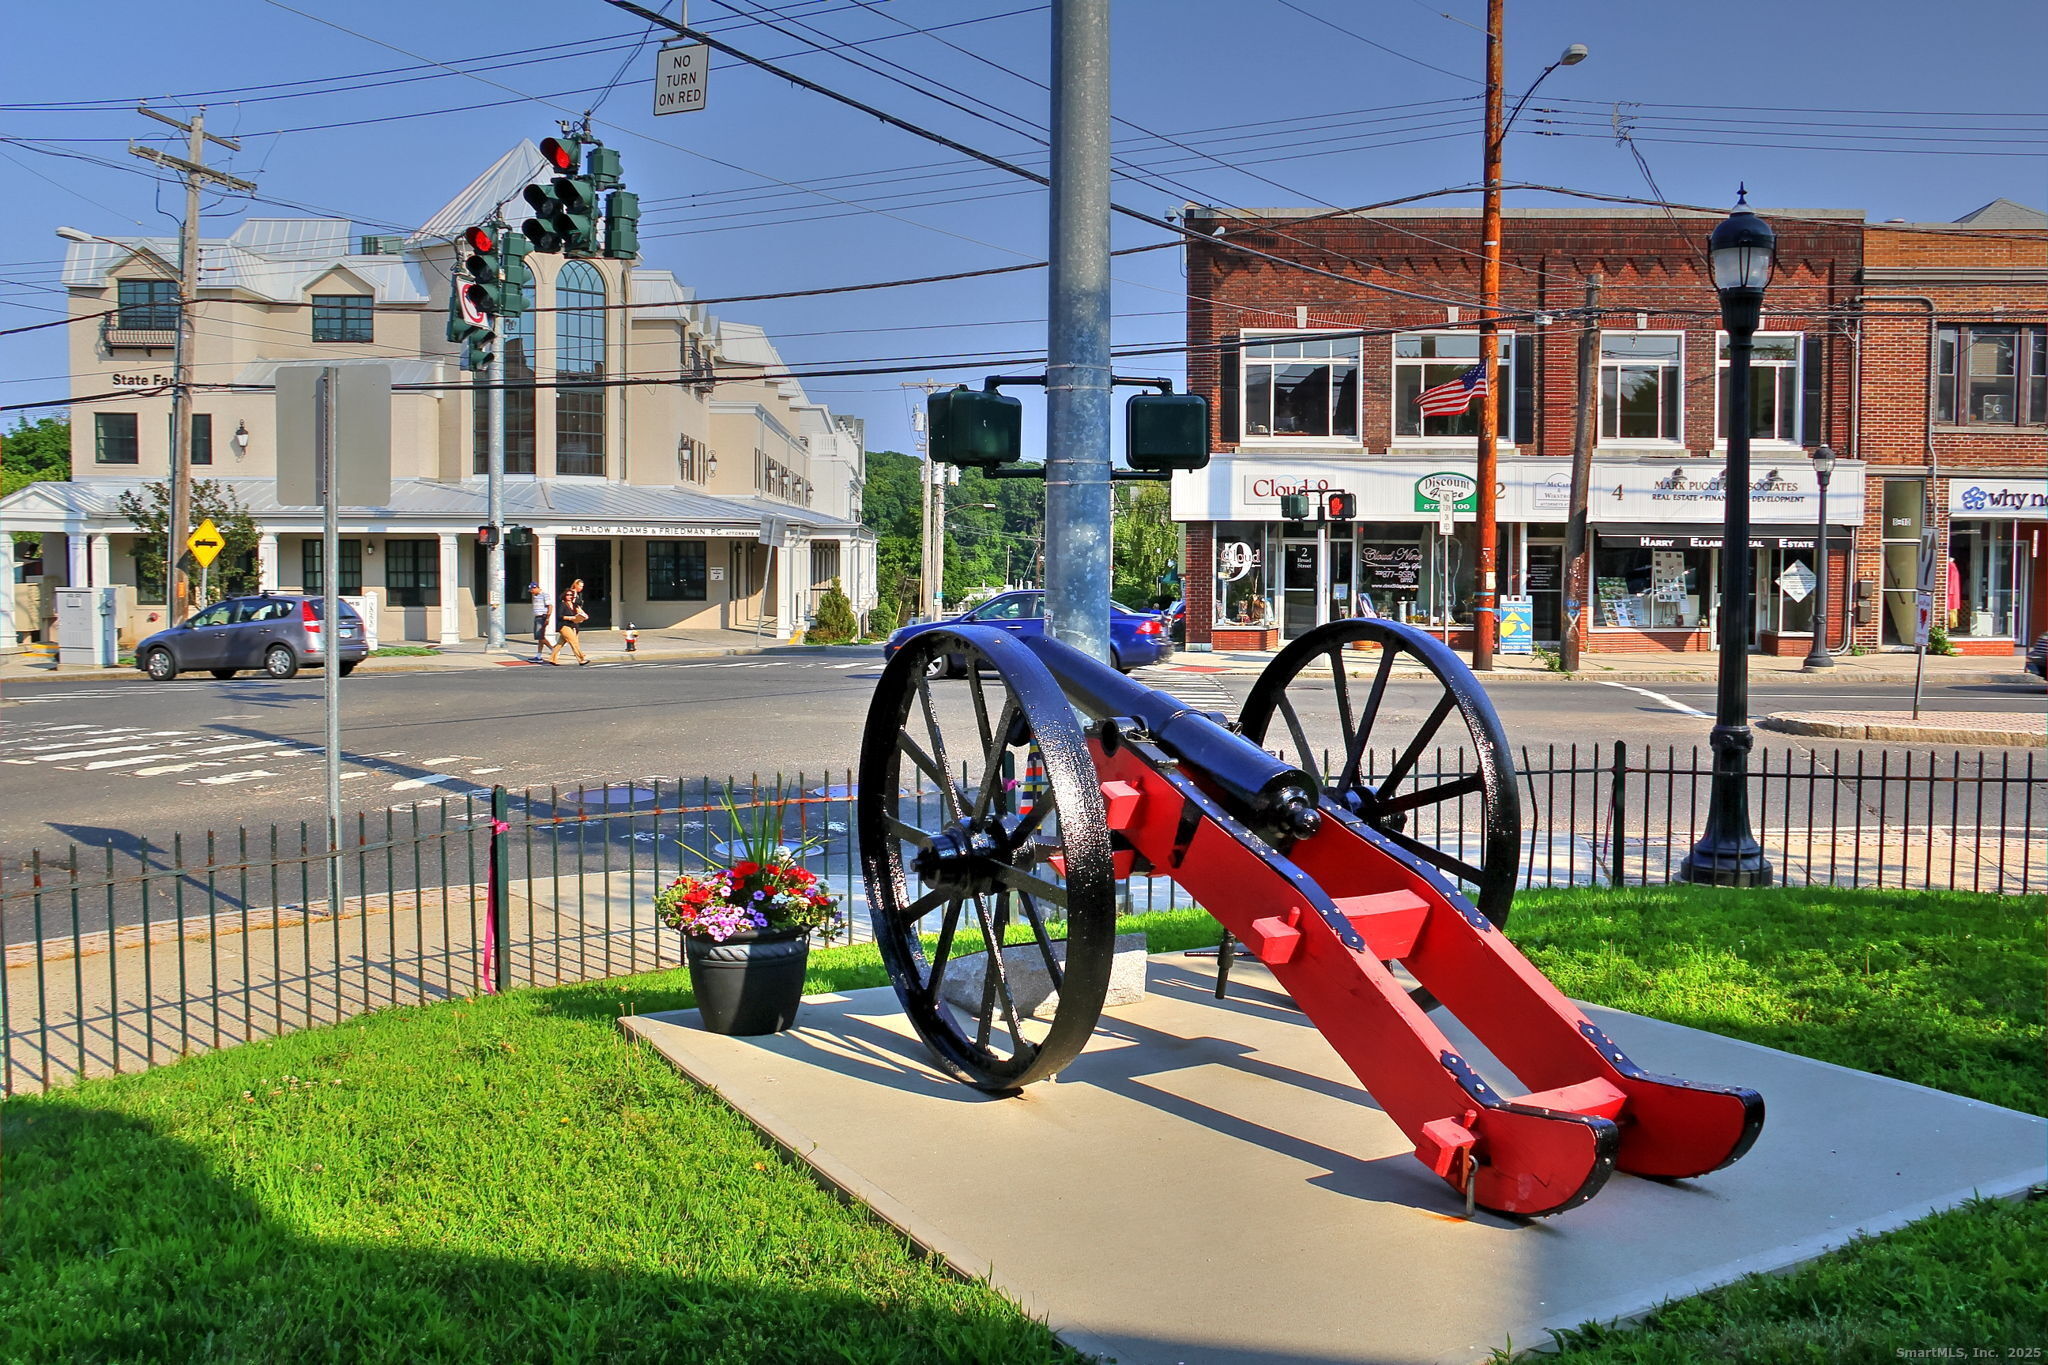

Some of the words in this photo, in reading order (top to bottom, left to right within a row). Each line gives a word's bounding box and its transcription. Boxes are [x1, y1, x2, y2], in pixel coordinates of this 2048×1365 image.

[673, 55, 691, 69] NO
[667, 71, 697, 88] TURN
[659, 92, 675, 107] ON
[678, 89, 701, 103] RED
[112, 374, 149, 386] State
[153, 374, 174, 386] Far
[1253, 478, 1309, 497] Cloud
[1424, 477, 1470, 490] Discount
[1653, 480, 1685, 490] MARK
[1688, 481, 1719, 491] PUCCI
[1749, 481, 1798, 492] SOCIATES
[1429, 487, 1464, 499] Fce
[1611, 483, 1624, 501] 4
[1652, 493, 1671, 501] REAL
[1673, 493, 1697, 501] ESTATE
[1704, 494, 1726, 502] FINAN
[1752, 495, 1804, 503] DEVELOPMENT
[1988, 488, 2029, 510] why
[1778, 538, 1815, 548] ESTATE
[1221, 549, 1260, 563] Cloud
[1301, 548, 1308, 557] 2
[1363, 548, 1394, 561] Cloud
[1394, 548, 1423, 561] Nine
[1225, 542, 1253, 582] 9
